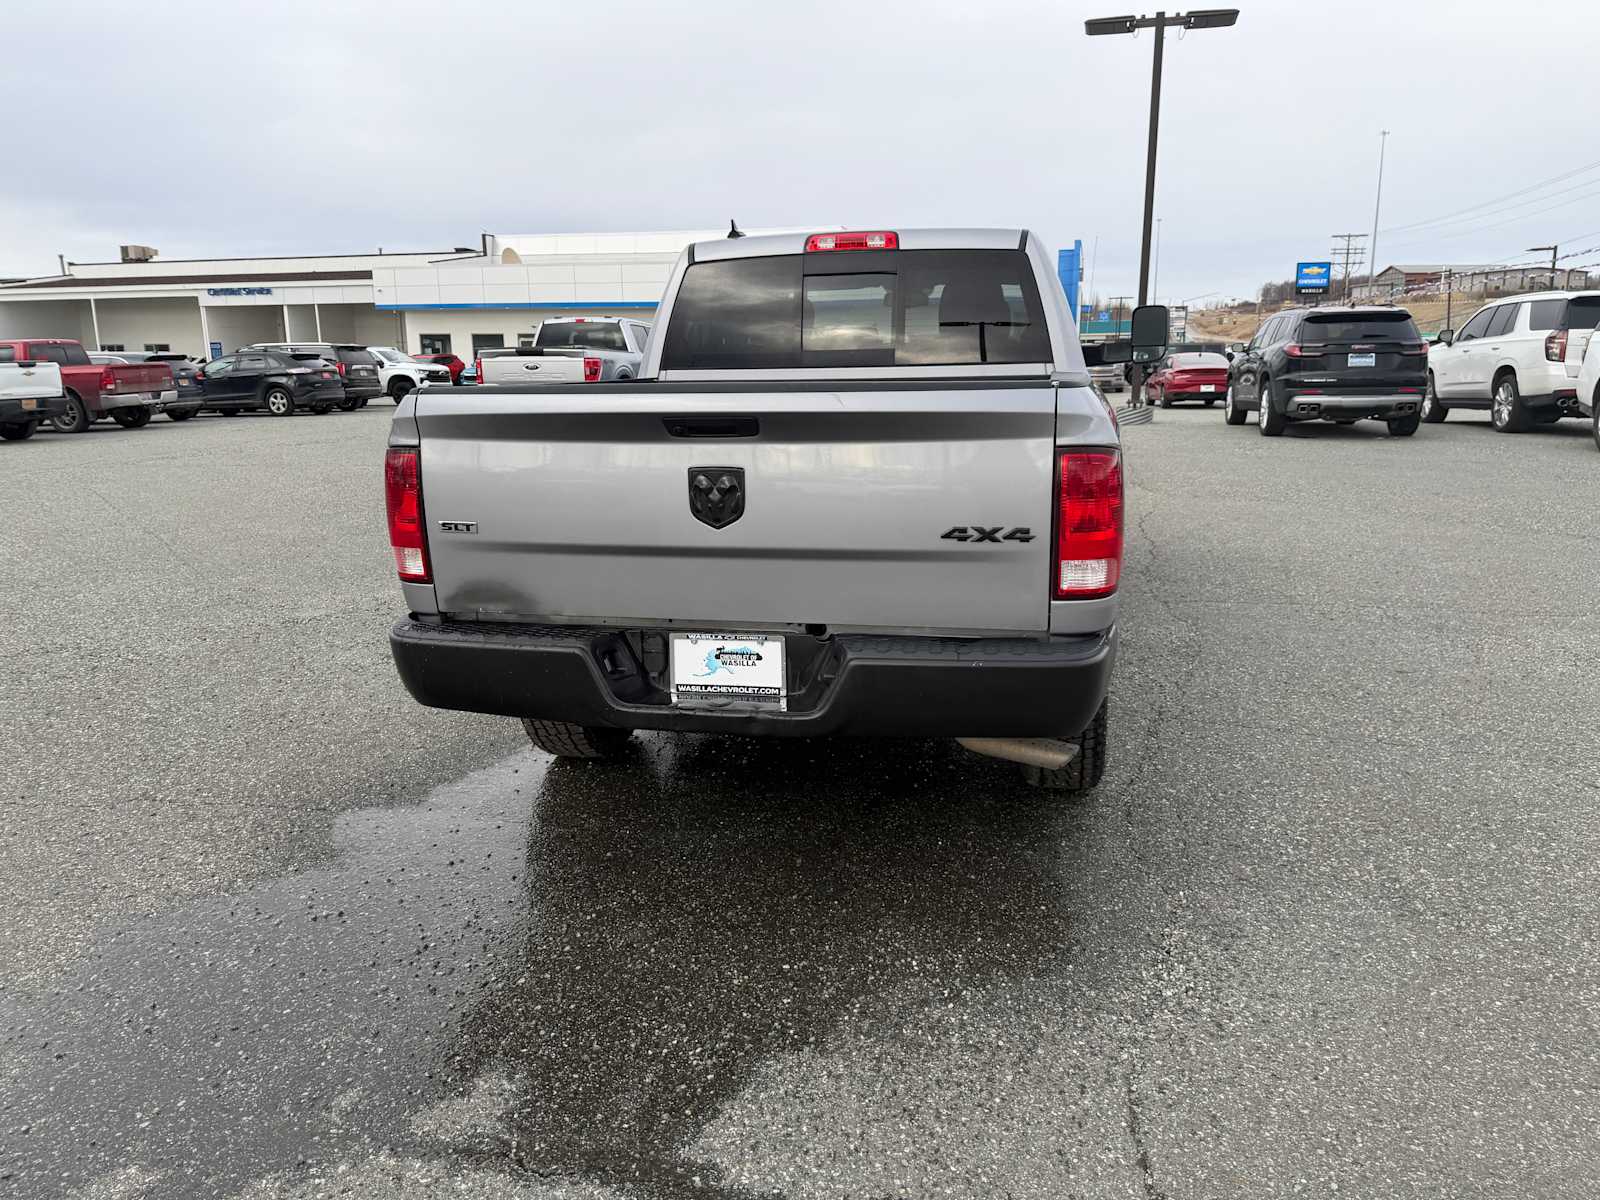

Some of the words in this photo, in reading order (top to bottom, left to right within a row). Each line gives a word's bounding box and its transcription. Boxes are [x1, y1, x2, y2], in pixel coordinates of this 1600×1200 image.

[440, 522, 475, 532] SLT
[940, 526, 1037, 543] 4X4
[677, 685, 779, 695] WASILLACHEVROLET.COM
